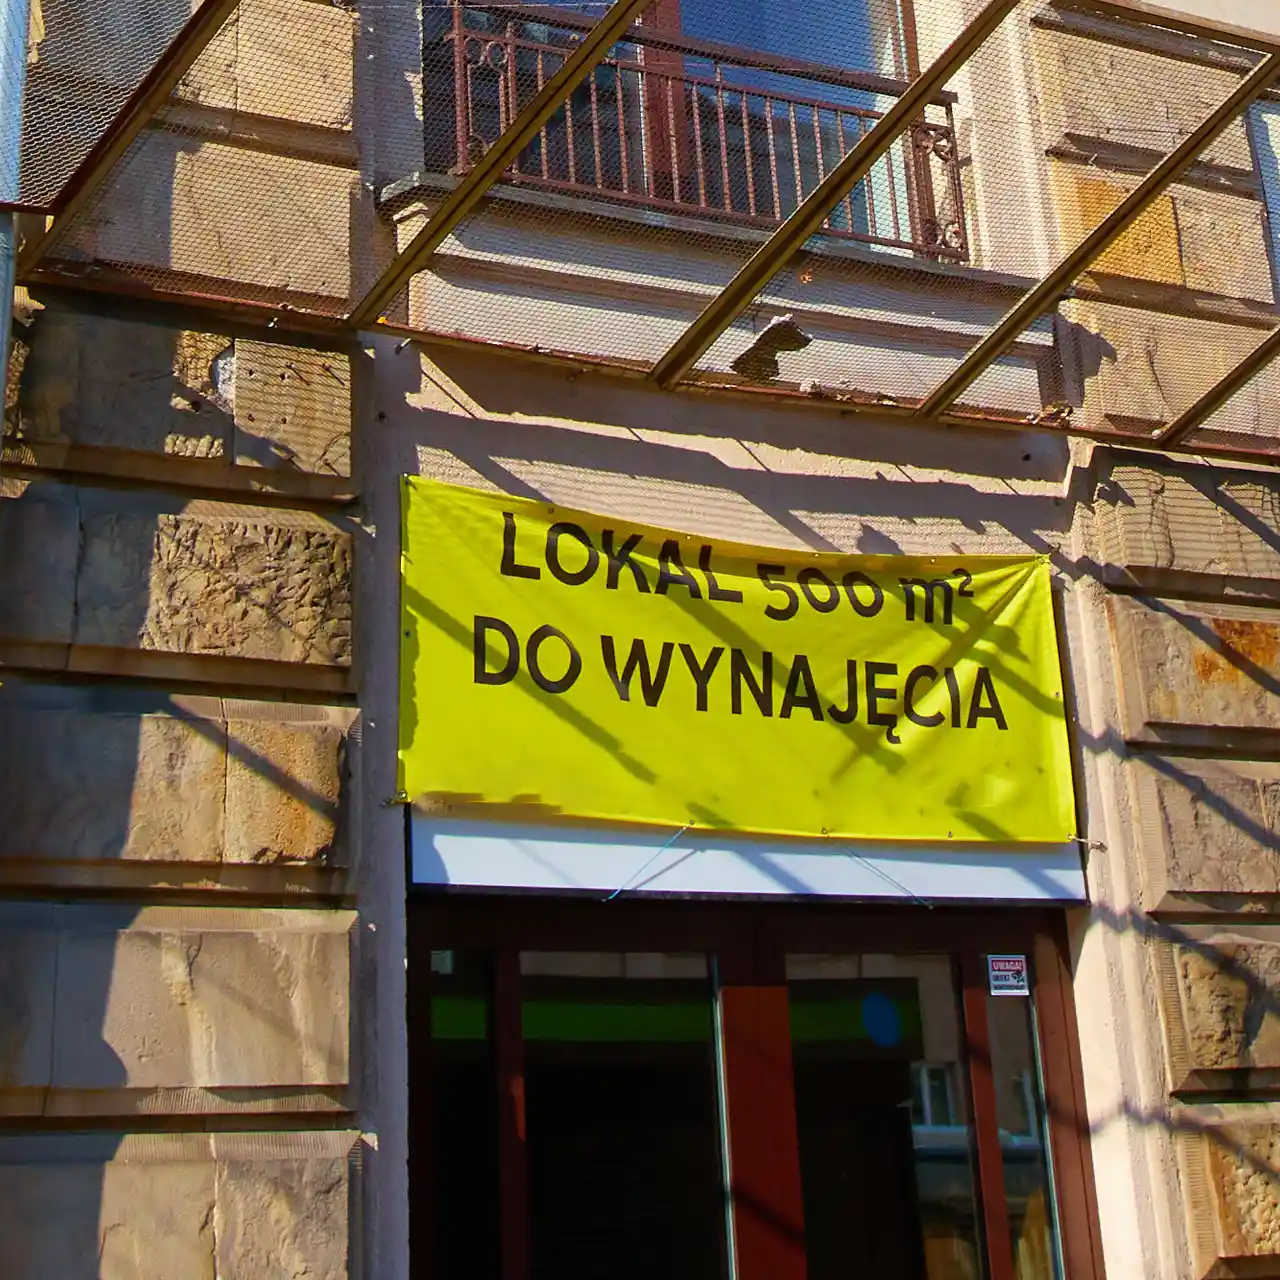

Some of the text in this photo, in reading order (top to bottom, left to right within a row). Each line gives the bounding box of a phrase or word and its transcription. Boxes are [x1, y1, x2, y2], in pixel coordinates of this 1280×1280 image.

[499, 511, 744, 604] LOKAL
[755, 563, 885, 622] 500
[472, 614, 1009, 745] DO WYNAJĘCIA
